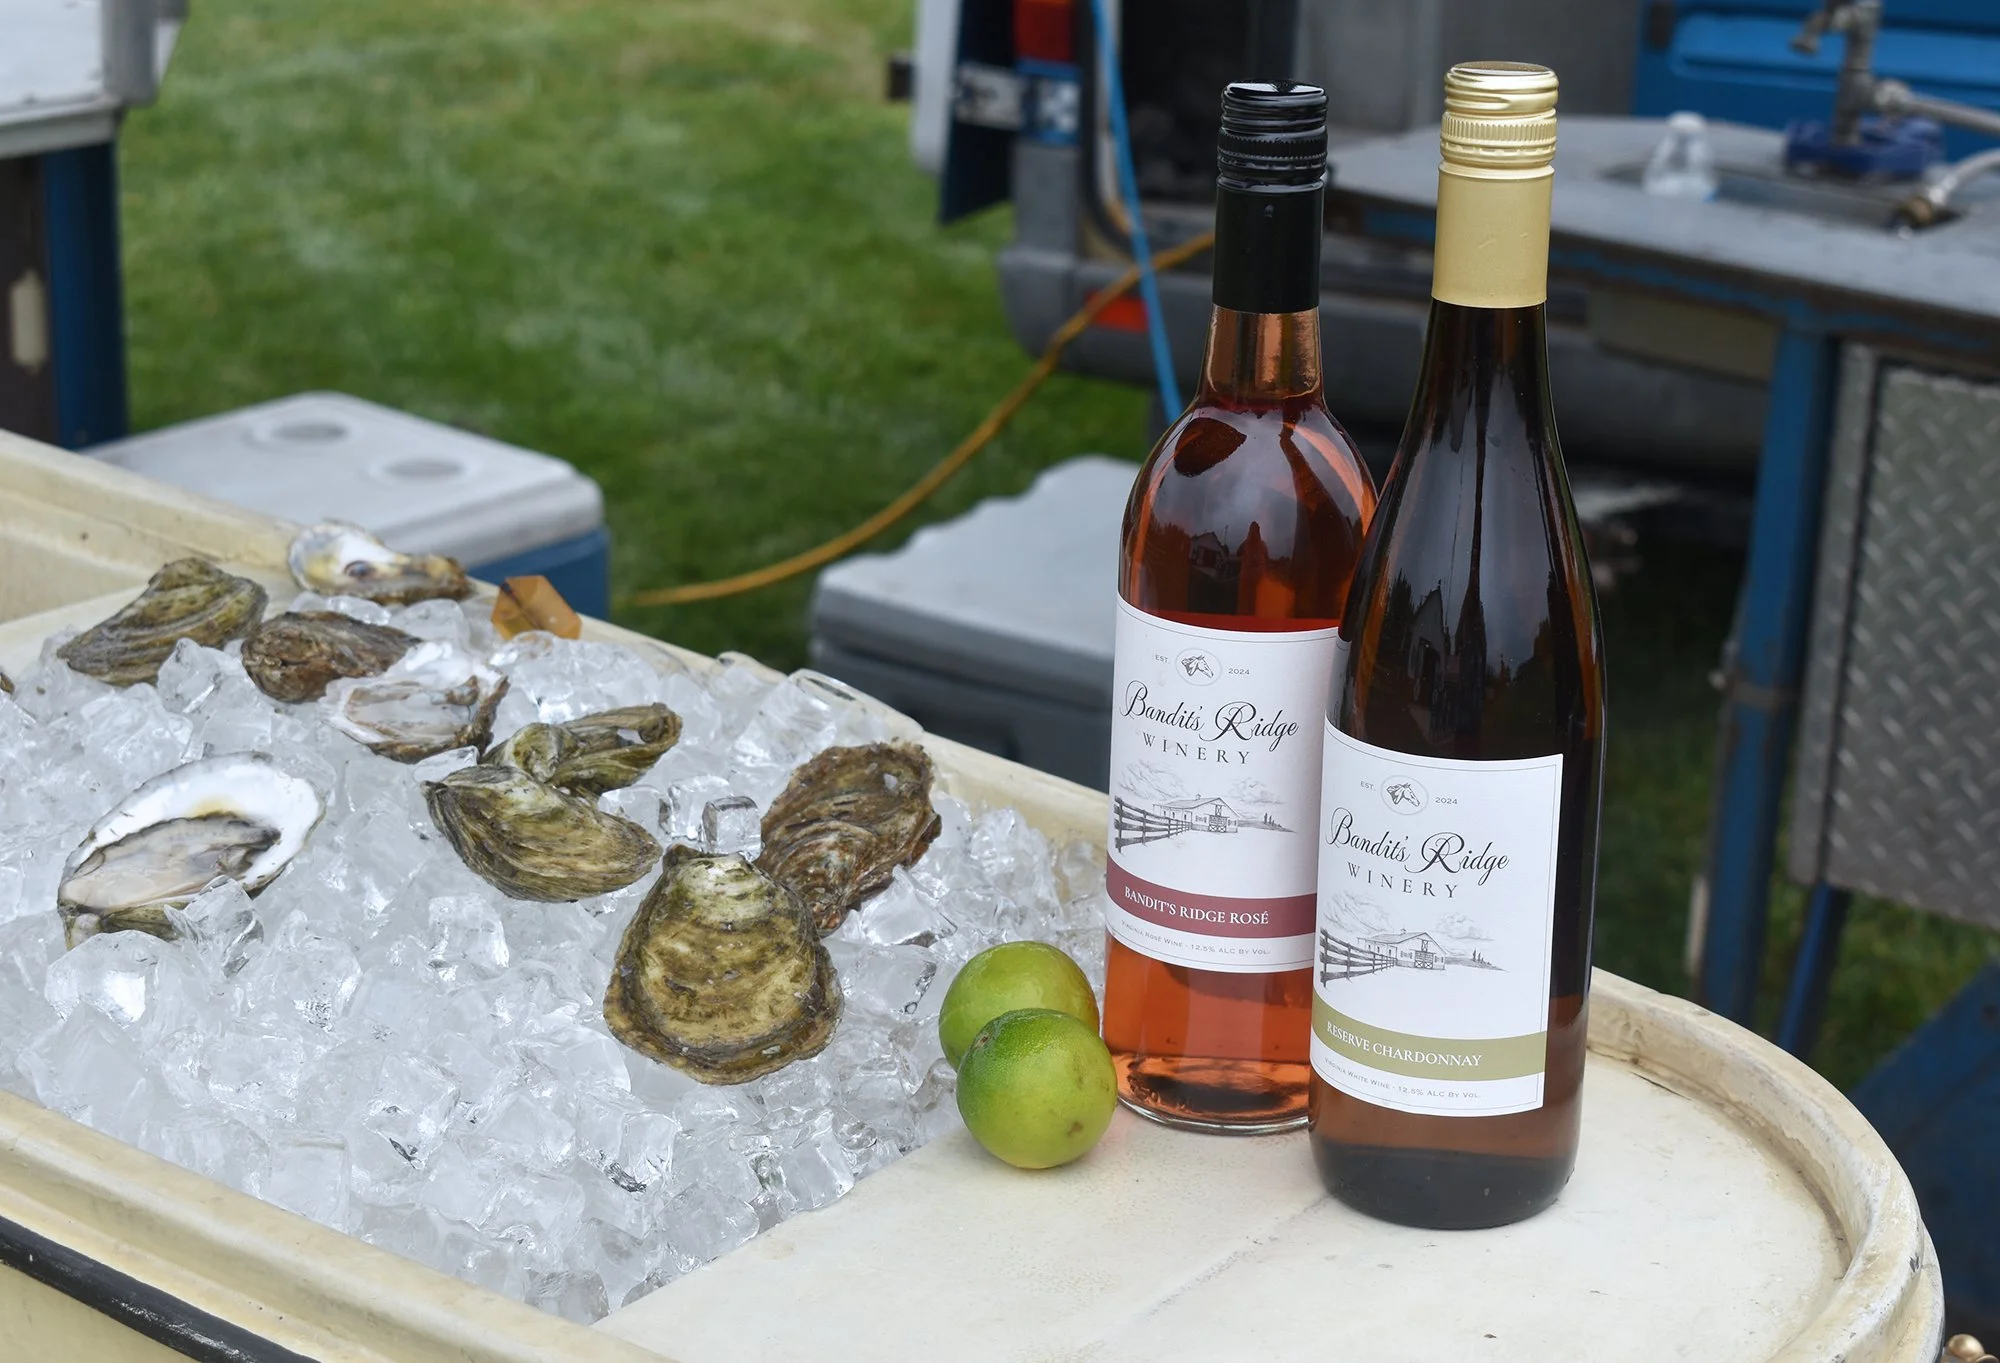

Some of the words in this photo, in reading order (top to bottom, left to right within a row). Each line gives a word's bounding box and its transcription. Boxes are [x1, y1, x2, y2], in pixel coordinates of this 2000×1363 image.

[1228, 667, 1250, 675] 2024
[1120, 680, 1204, 731] Bandit's
[1199, 701, 1299, 752] Ridge
[1143, 732, 1250, 764] WINERY
[1360, 780, 1376, 791] EST.
[1435, 796, 1458, 805] 2024
[1325, 807, 1411, 862] Bandit's
[1404, 832, 1510, 886] Ridge
[1347, 861, 1458, 898] WINERY
[1125, 886, 1176, 915] BANDIT'S
[1180, 905, 1226, 923] RIDGE
[1230, 911, 1269, 925] ROSÉ
[1327, 1020, 1370, 1051] RESERVE
[1373, 1042, 1482, 1066] CHARDONNAY
[1398, 1086, 1423, 1096] 12.5%
